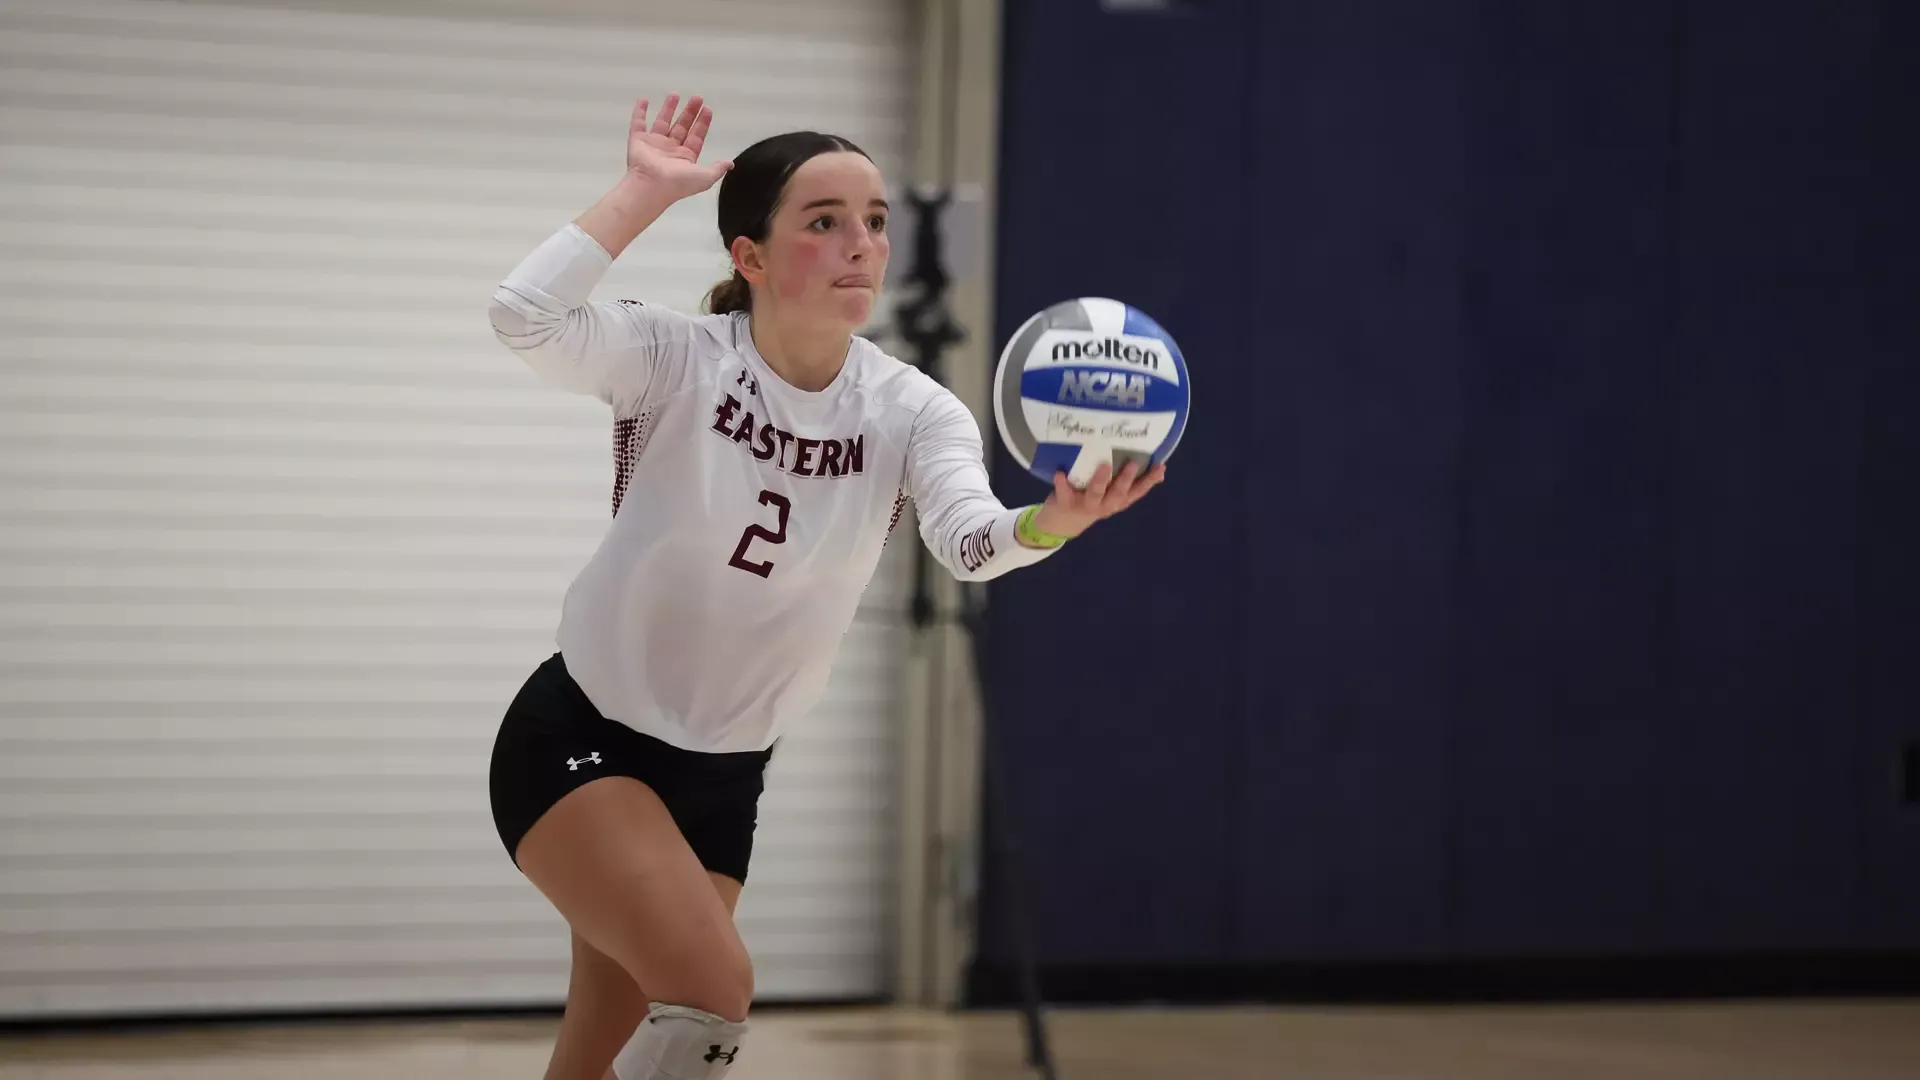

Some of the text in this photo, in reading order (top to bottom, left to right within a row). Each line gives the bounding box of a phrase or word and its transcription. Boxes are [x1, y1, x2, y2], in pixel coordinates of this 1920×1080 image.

[1052, 336, 1159, 369] molten
[1058, 369, 1146, 408] NCAA
[710, 392, 864, 479] EASTERN
[728, 489, 791, 578] 2
